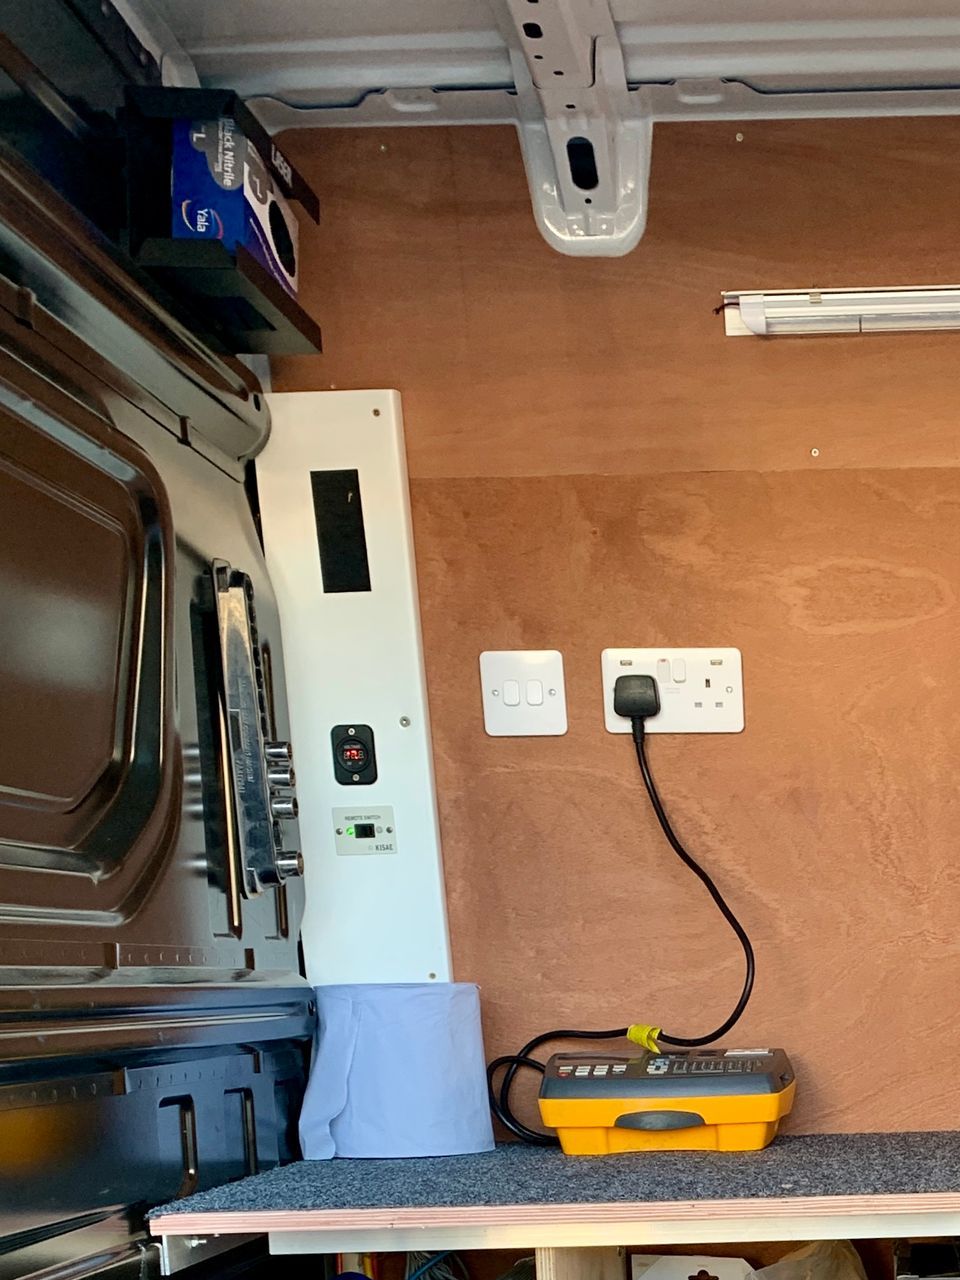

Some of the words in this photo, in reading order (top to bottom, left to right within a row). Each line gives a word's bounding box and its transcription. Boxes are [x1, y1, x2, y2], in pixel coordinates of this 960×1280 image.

[223, 150, 235, 187] Nitrile
[196, 208, 208, 233] Yala
[375, 843, 394, 851] KISAE
